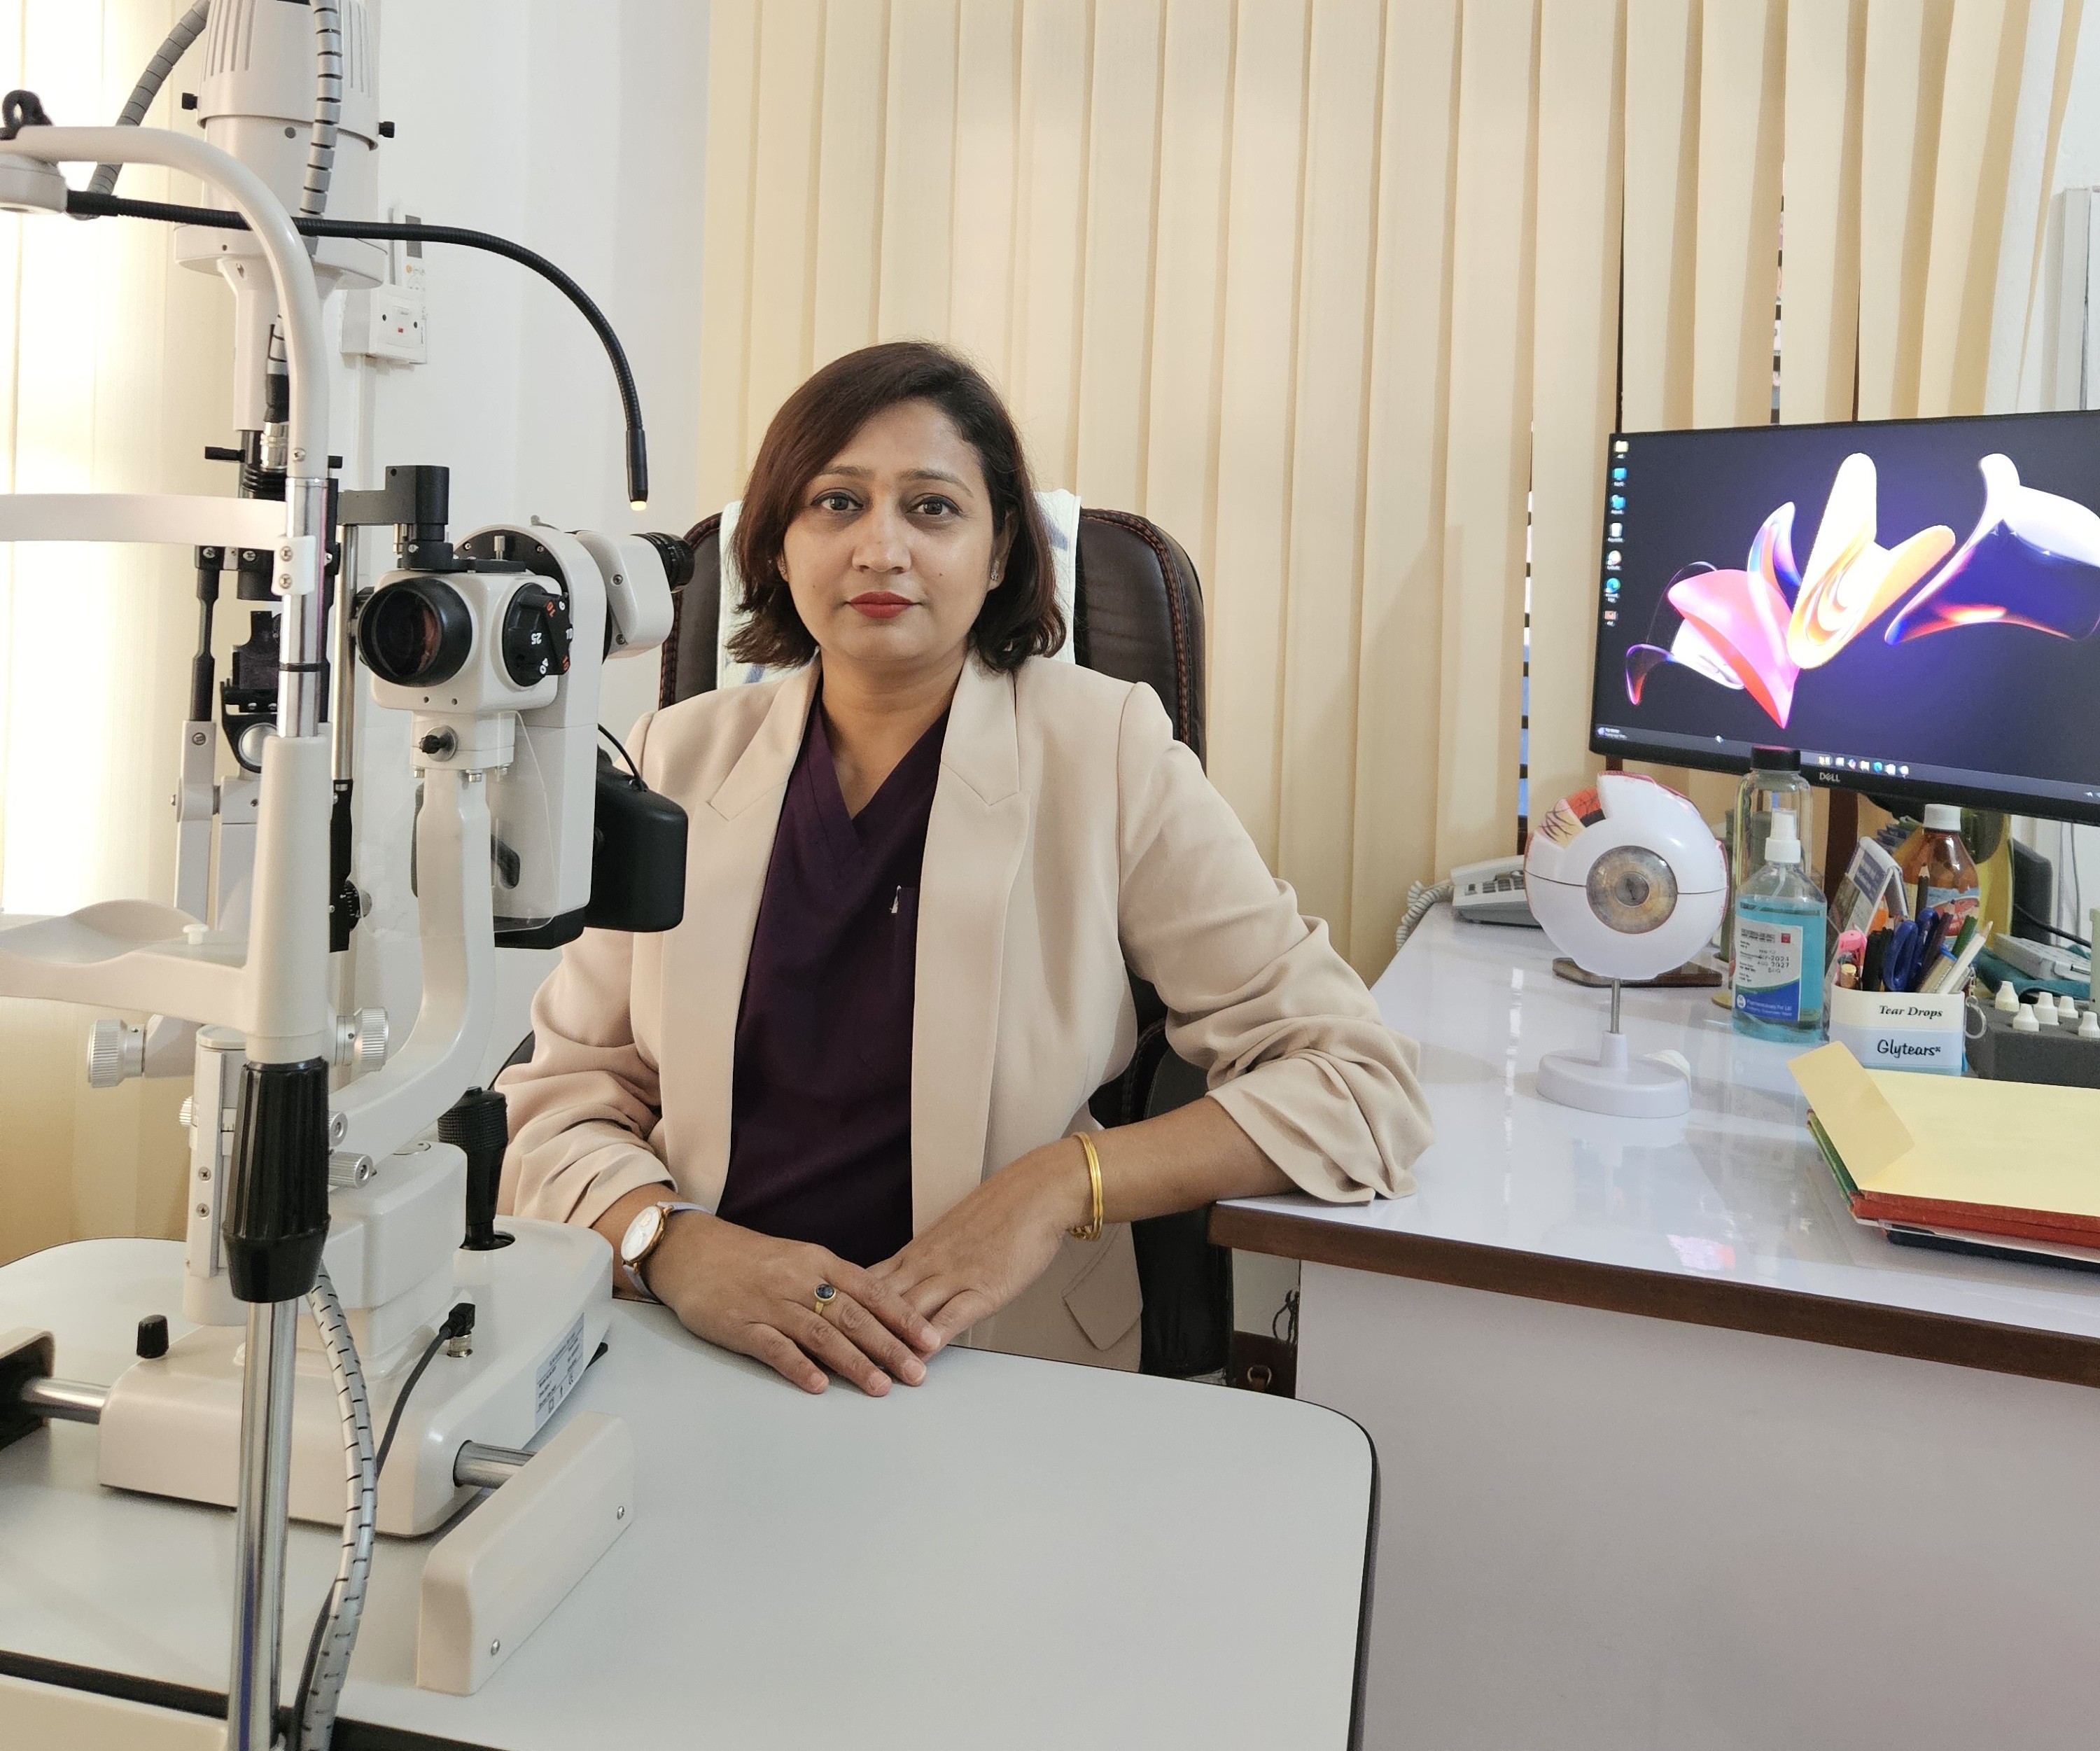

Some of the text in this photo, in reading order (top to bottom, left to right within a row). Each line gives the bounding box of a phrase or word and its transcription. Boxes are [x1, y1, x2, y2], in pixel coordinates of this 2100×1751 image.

[531, 633, 542, 644] 25
[540, 658, 548, 674] 40
[1819, 772, 1840, 782] DELL
[1879, 1005, 1943, 1019] Tear Drops
